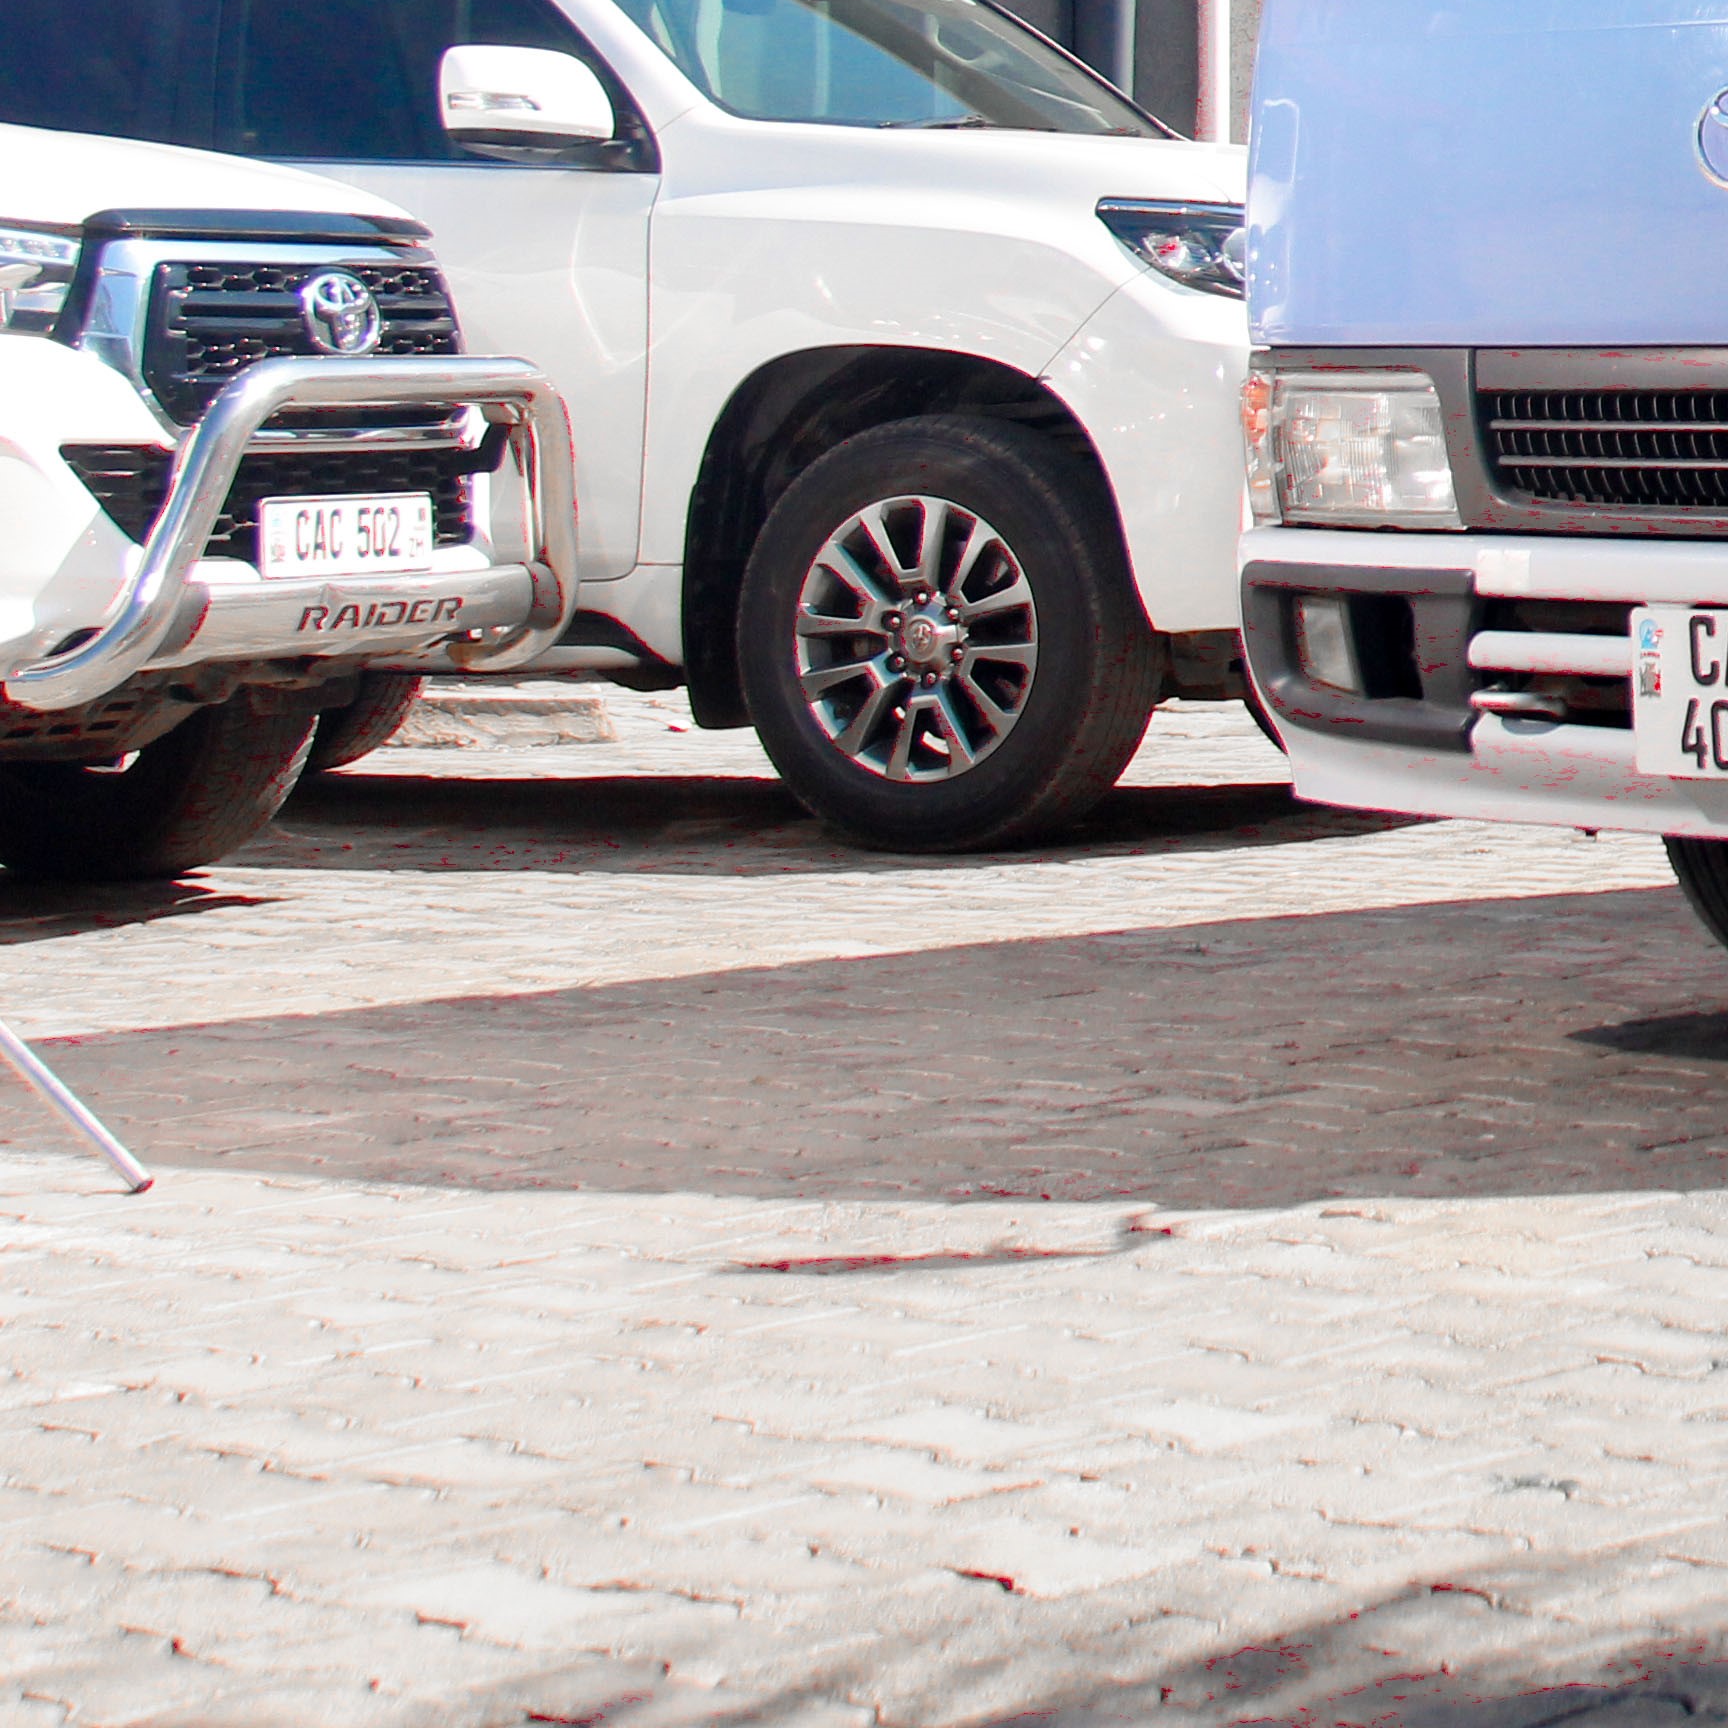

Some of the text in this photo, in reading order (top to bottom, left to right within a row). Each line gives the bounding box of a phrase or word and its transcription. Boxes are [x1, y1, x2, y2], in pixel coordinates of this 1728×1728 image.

[295, 508, 343, 561] CAC
[357, 506, 401, 558] 502
[296, 596, 465, 632] RAIDER
